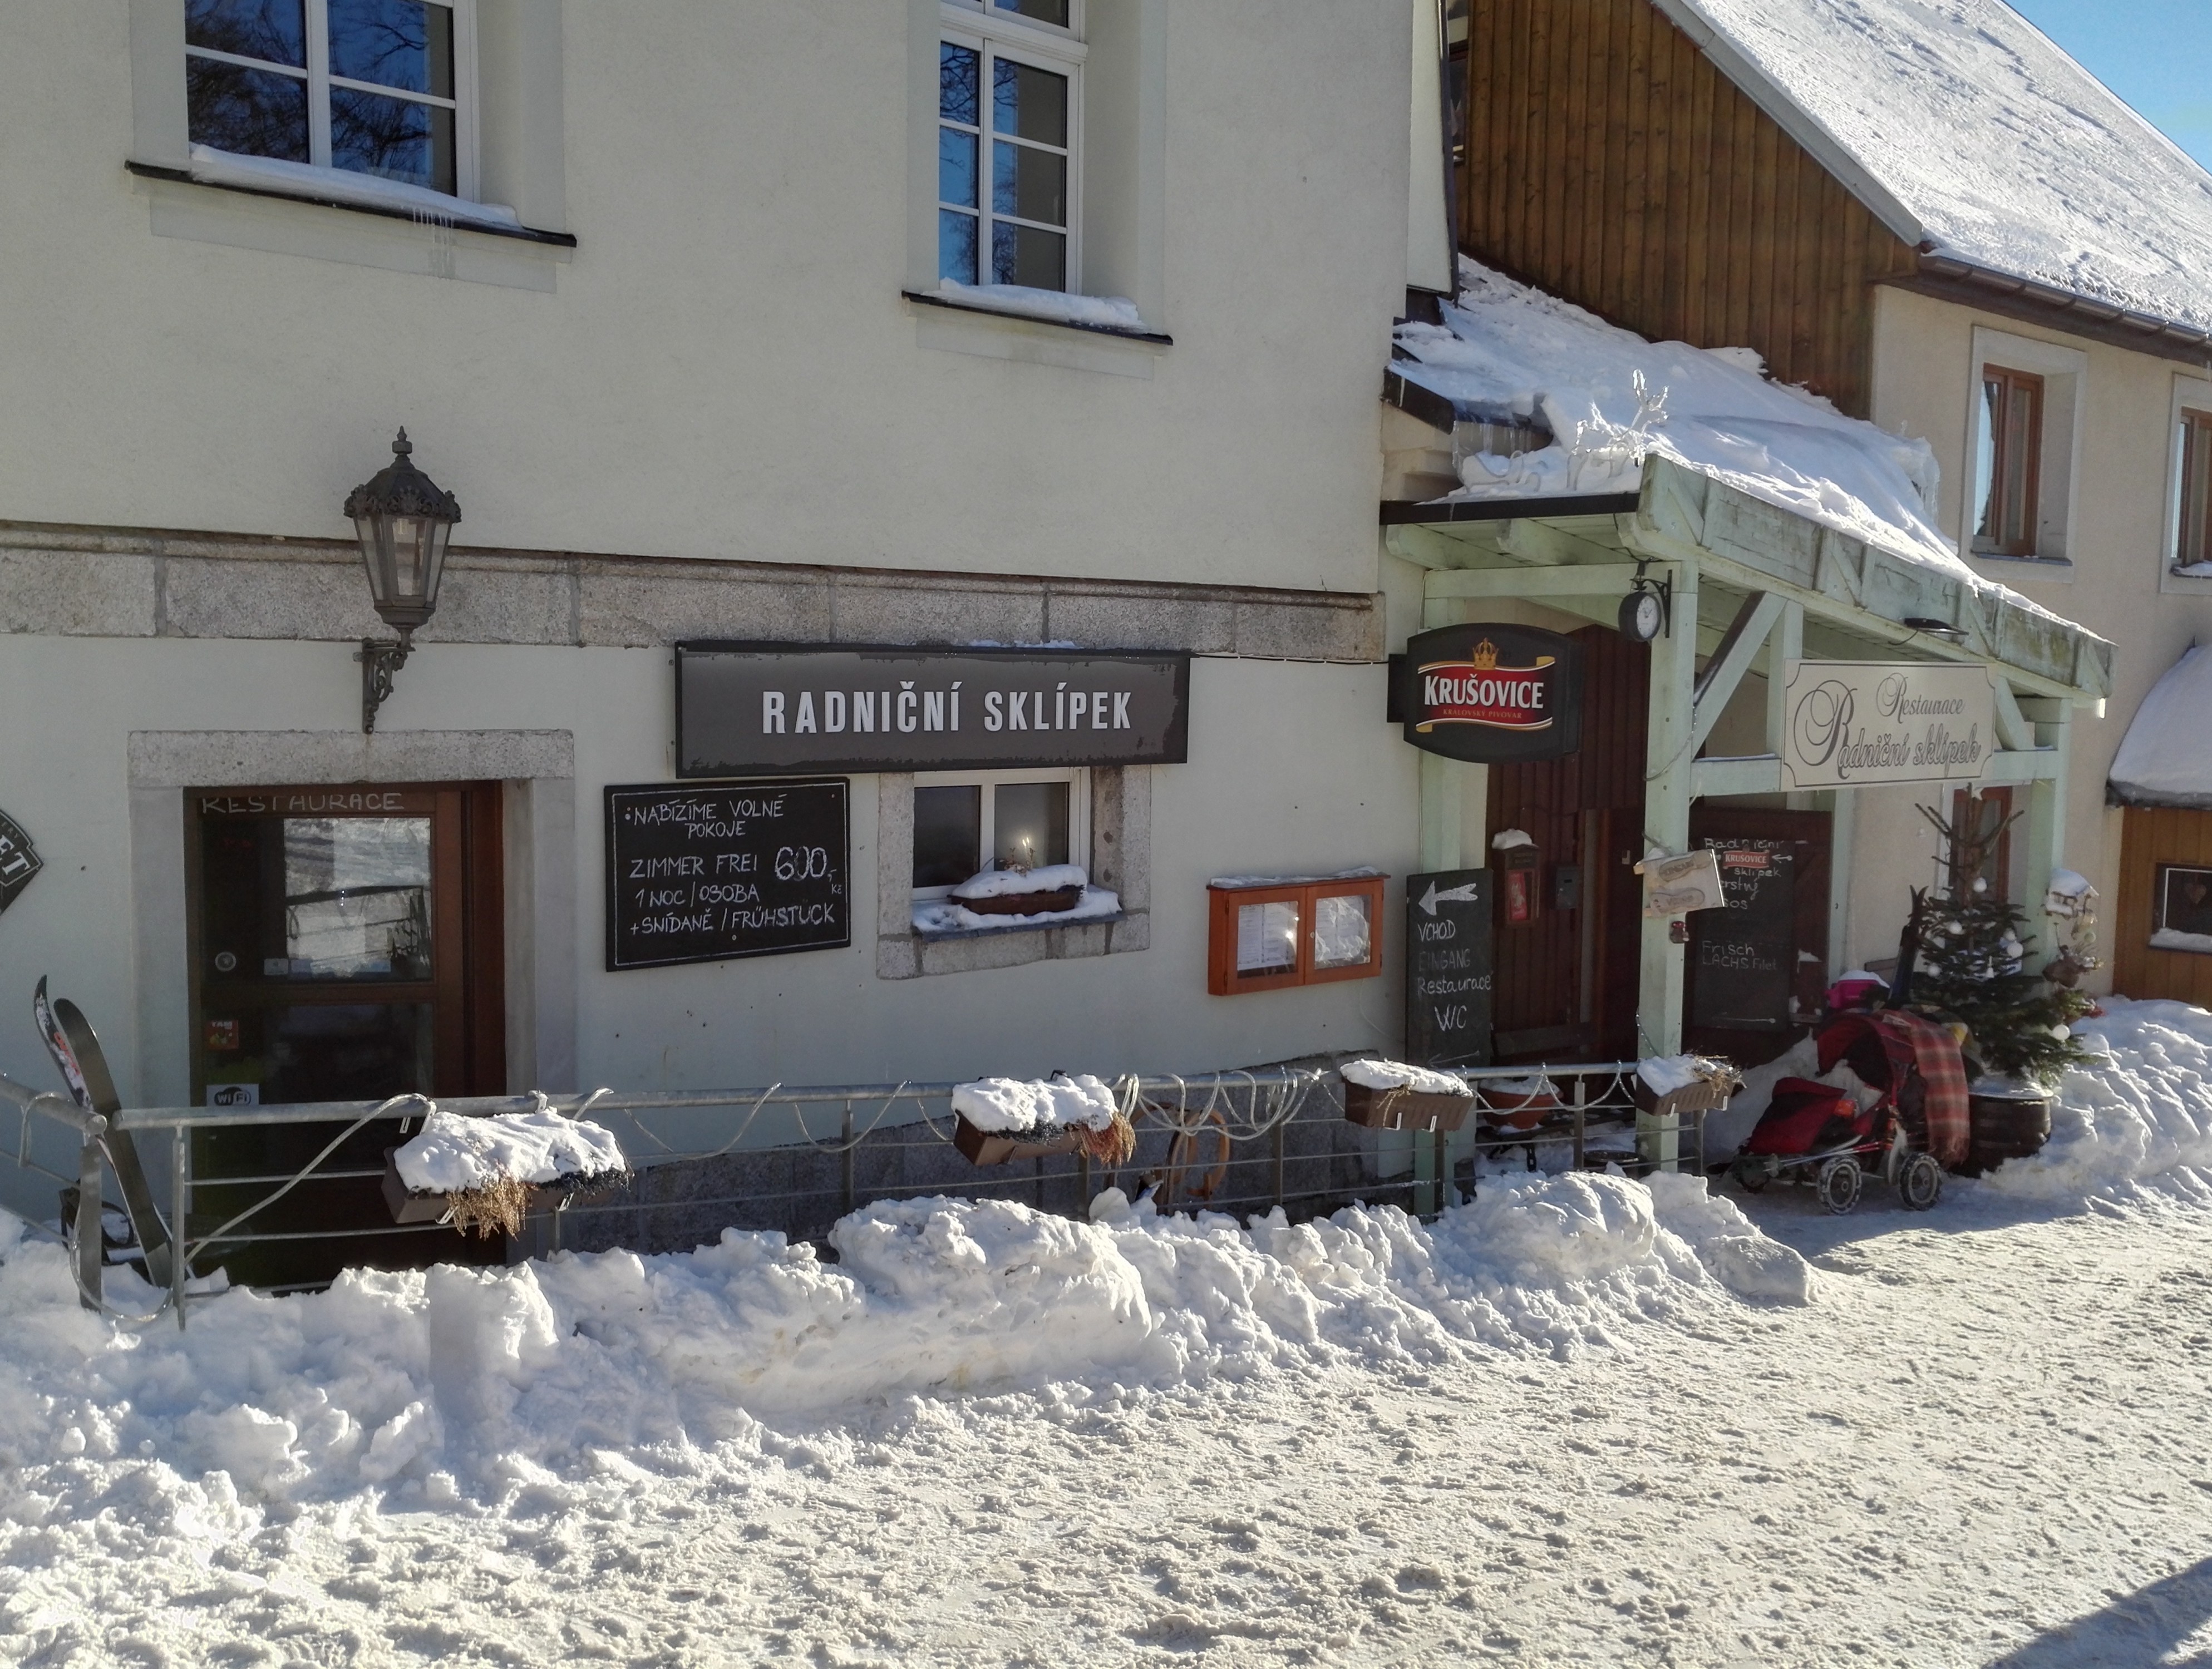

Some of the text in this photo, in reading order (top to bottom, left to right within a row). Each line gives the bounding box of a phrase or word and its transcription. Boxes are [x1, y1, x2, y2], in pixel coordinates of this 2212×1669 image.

[1424, 673, 1544, 709] KRUŠOVICE
[1875, 672, 1964, 724] Restaurace
[762, 681, 1132, 734] RADNIČNÍ SKLÍPEK
[1489, 710, 1522, 719] PIVOVAR
[201, 792, 405, 813] RESTAURACE
[684, 820, 746, 840] POKOJE
[629, 856, 705, 878] ZIMMER
[716, 853, 757, 875] FREI
[650, 889, 686, 907] NOC
[1418, 919, 1456, 942] VCHOD
[1418, 949, 1471, 972] EINGANG
[1434, 1004, 1467, 1031] WC
